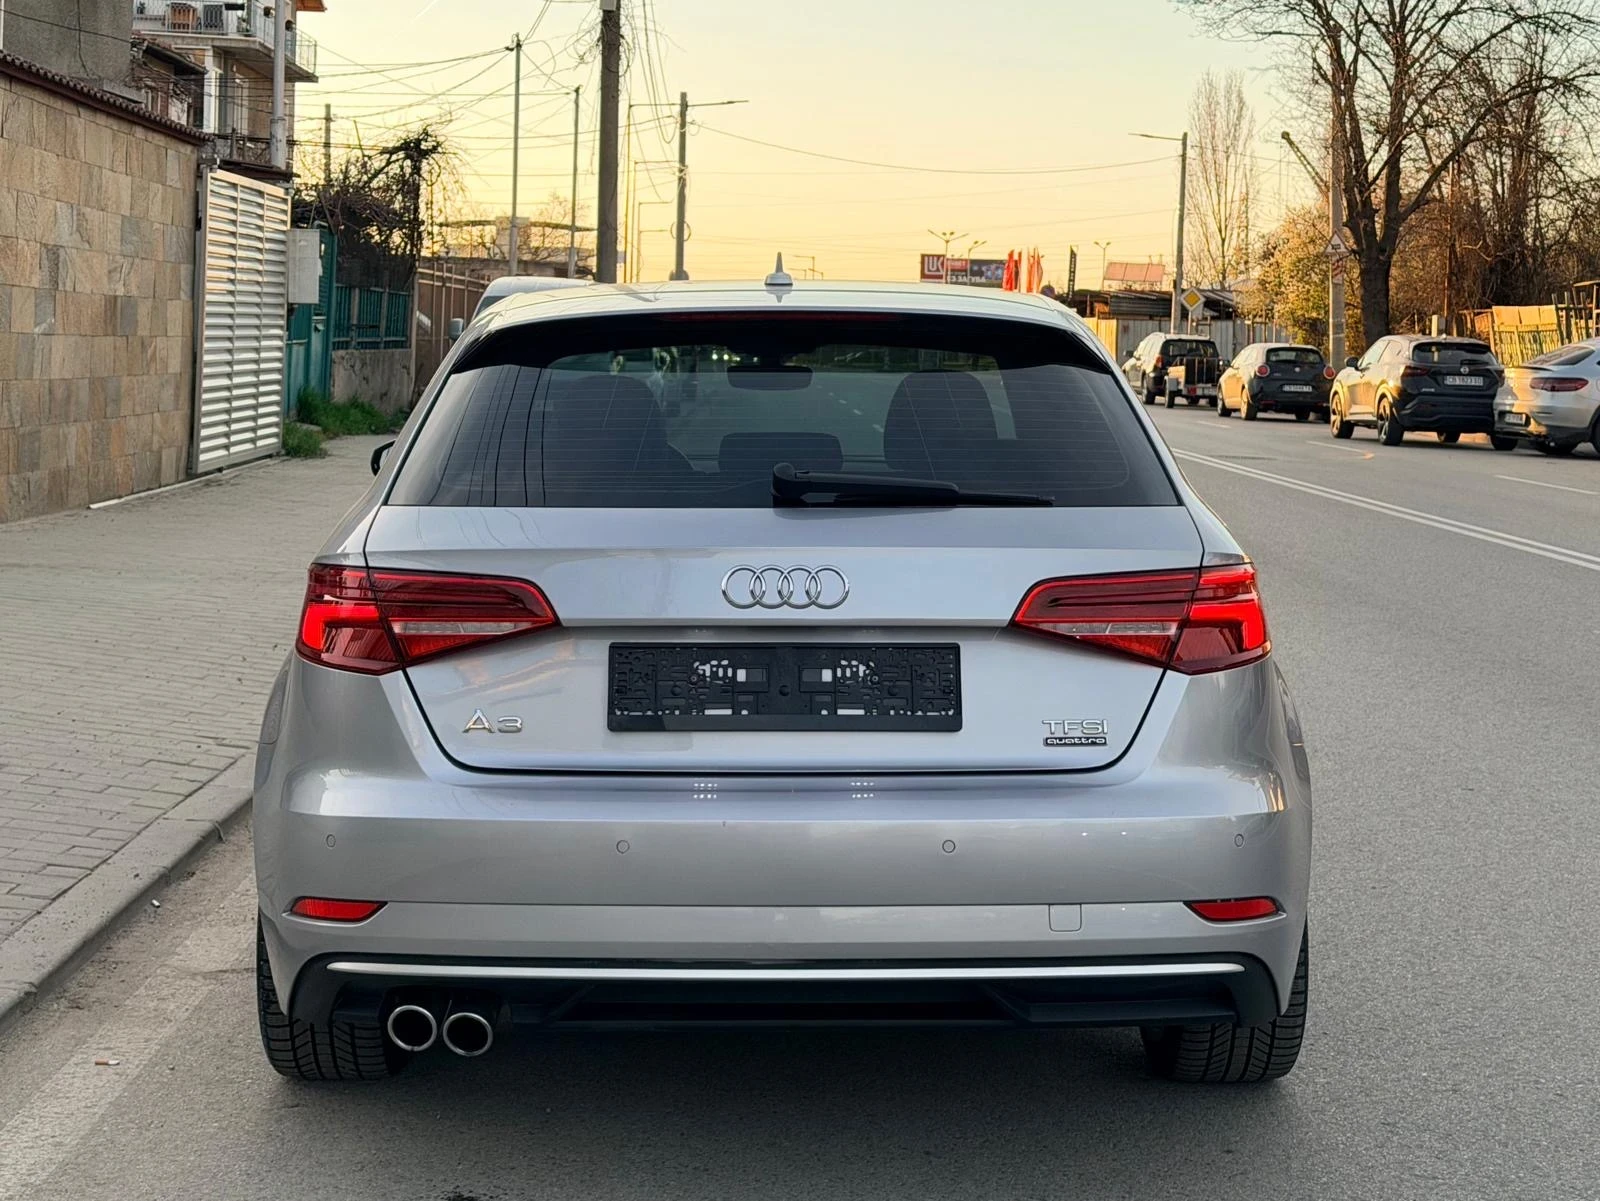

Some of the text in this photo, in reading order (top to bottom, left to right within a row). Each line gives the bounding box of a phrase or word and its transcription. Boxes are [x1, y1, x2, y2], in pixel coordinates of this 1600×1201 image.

[462, 709, 522, 733] A3
[1042, 719, 1108, 735] TFSI
[1046, 737, 1106, 745] quattro
